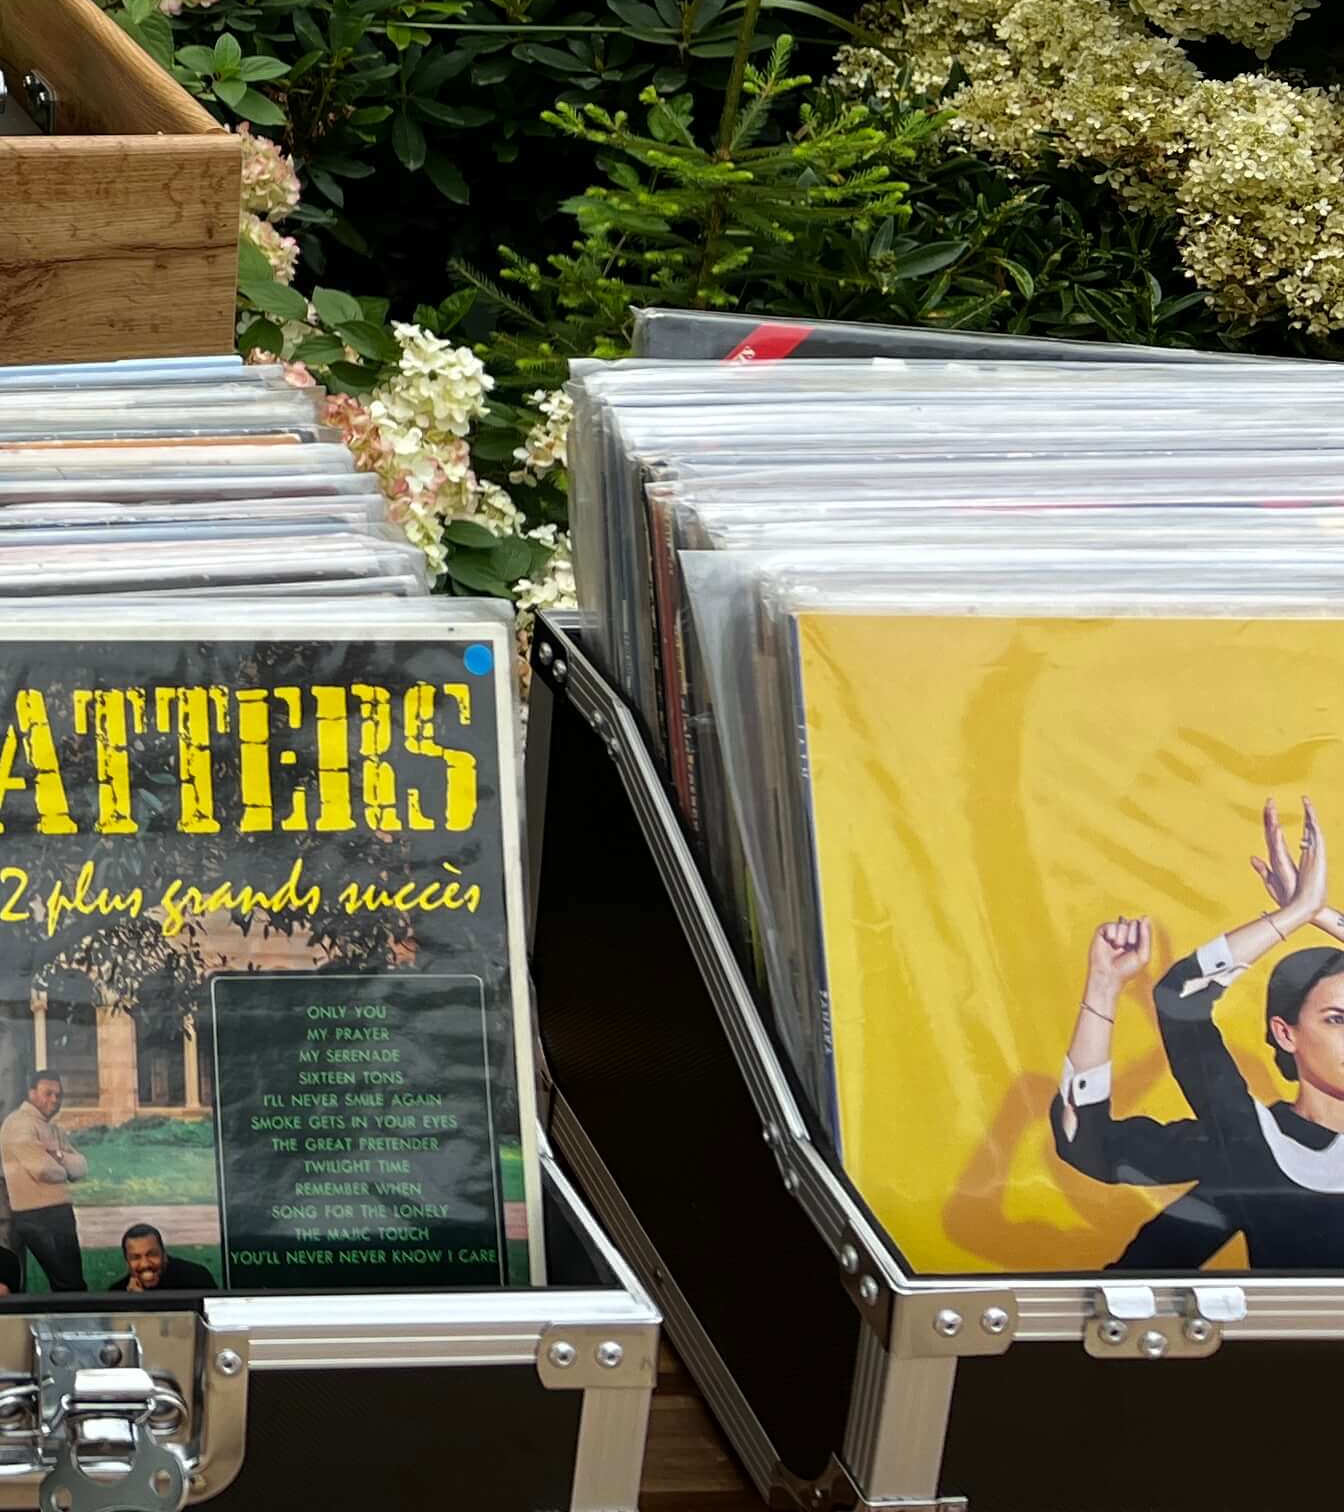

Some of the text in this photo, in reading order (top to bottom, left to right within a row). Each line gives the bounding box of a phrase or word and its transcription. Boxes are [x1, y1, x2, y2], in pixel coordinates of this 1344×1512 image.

[47, 860, 144, 937] plus
[160, 857, 321, 937] grands
[338, 861, 481, 914] succès
[306, 1006, 388, 1020] ONLY YOU
[306, 1027, 391, 1041] MY PRAYER
[298, 1049, 402, 1063] MY SERENADE
[298, 1071, 405, 1085] SIXTEEN TONS
[291, 1094, 339, 1108] NEVER
[344, 1094, 385, 1108] SMILE
[391, 1094, 443, 1108] AGAIN
[250, 1115, 458, 1130] SMOKE GETS IN YOUR EYES
[271, 1137, 441, 1152] THE GREAT PRETENDER
[303, 1159, 411, 1174] TWILIGHT TIME
[295, 1182, 422, 1197] REMEMBER WHEN
[271, 1204, 450, 1219] SONG FOR THE LONELY
[294, 1226, 322, 1241] THE
[378, 1226, 430, 1241] TOUCH
[286, 1249, 334, 1264] NEVER
[339, 1249, 387, 1264] NEVER
[392, 1249, 443, 1264] KNOW
[447, 1249, 454, 1264] I
[458, 1248, 498, 1263] CARE
